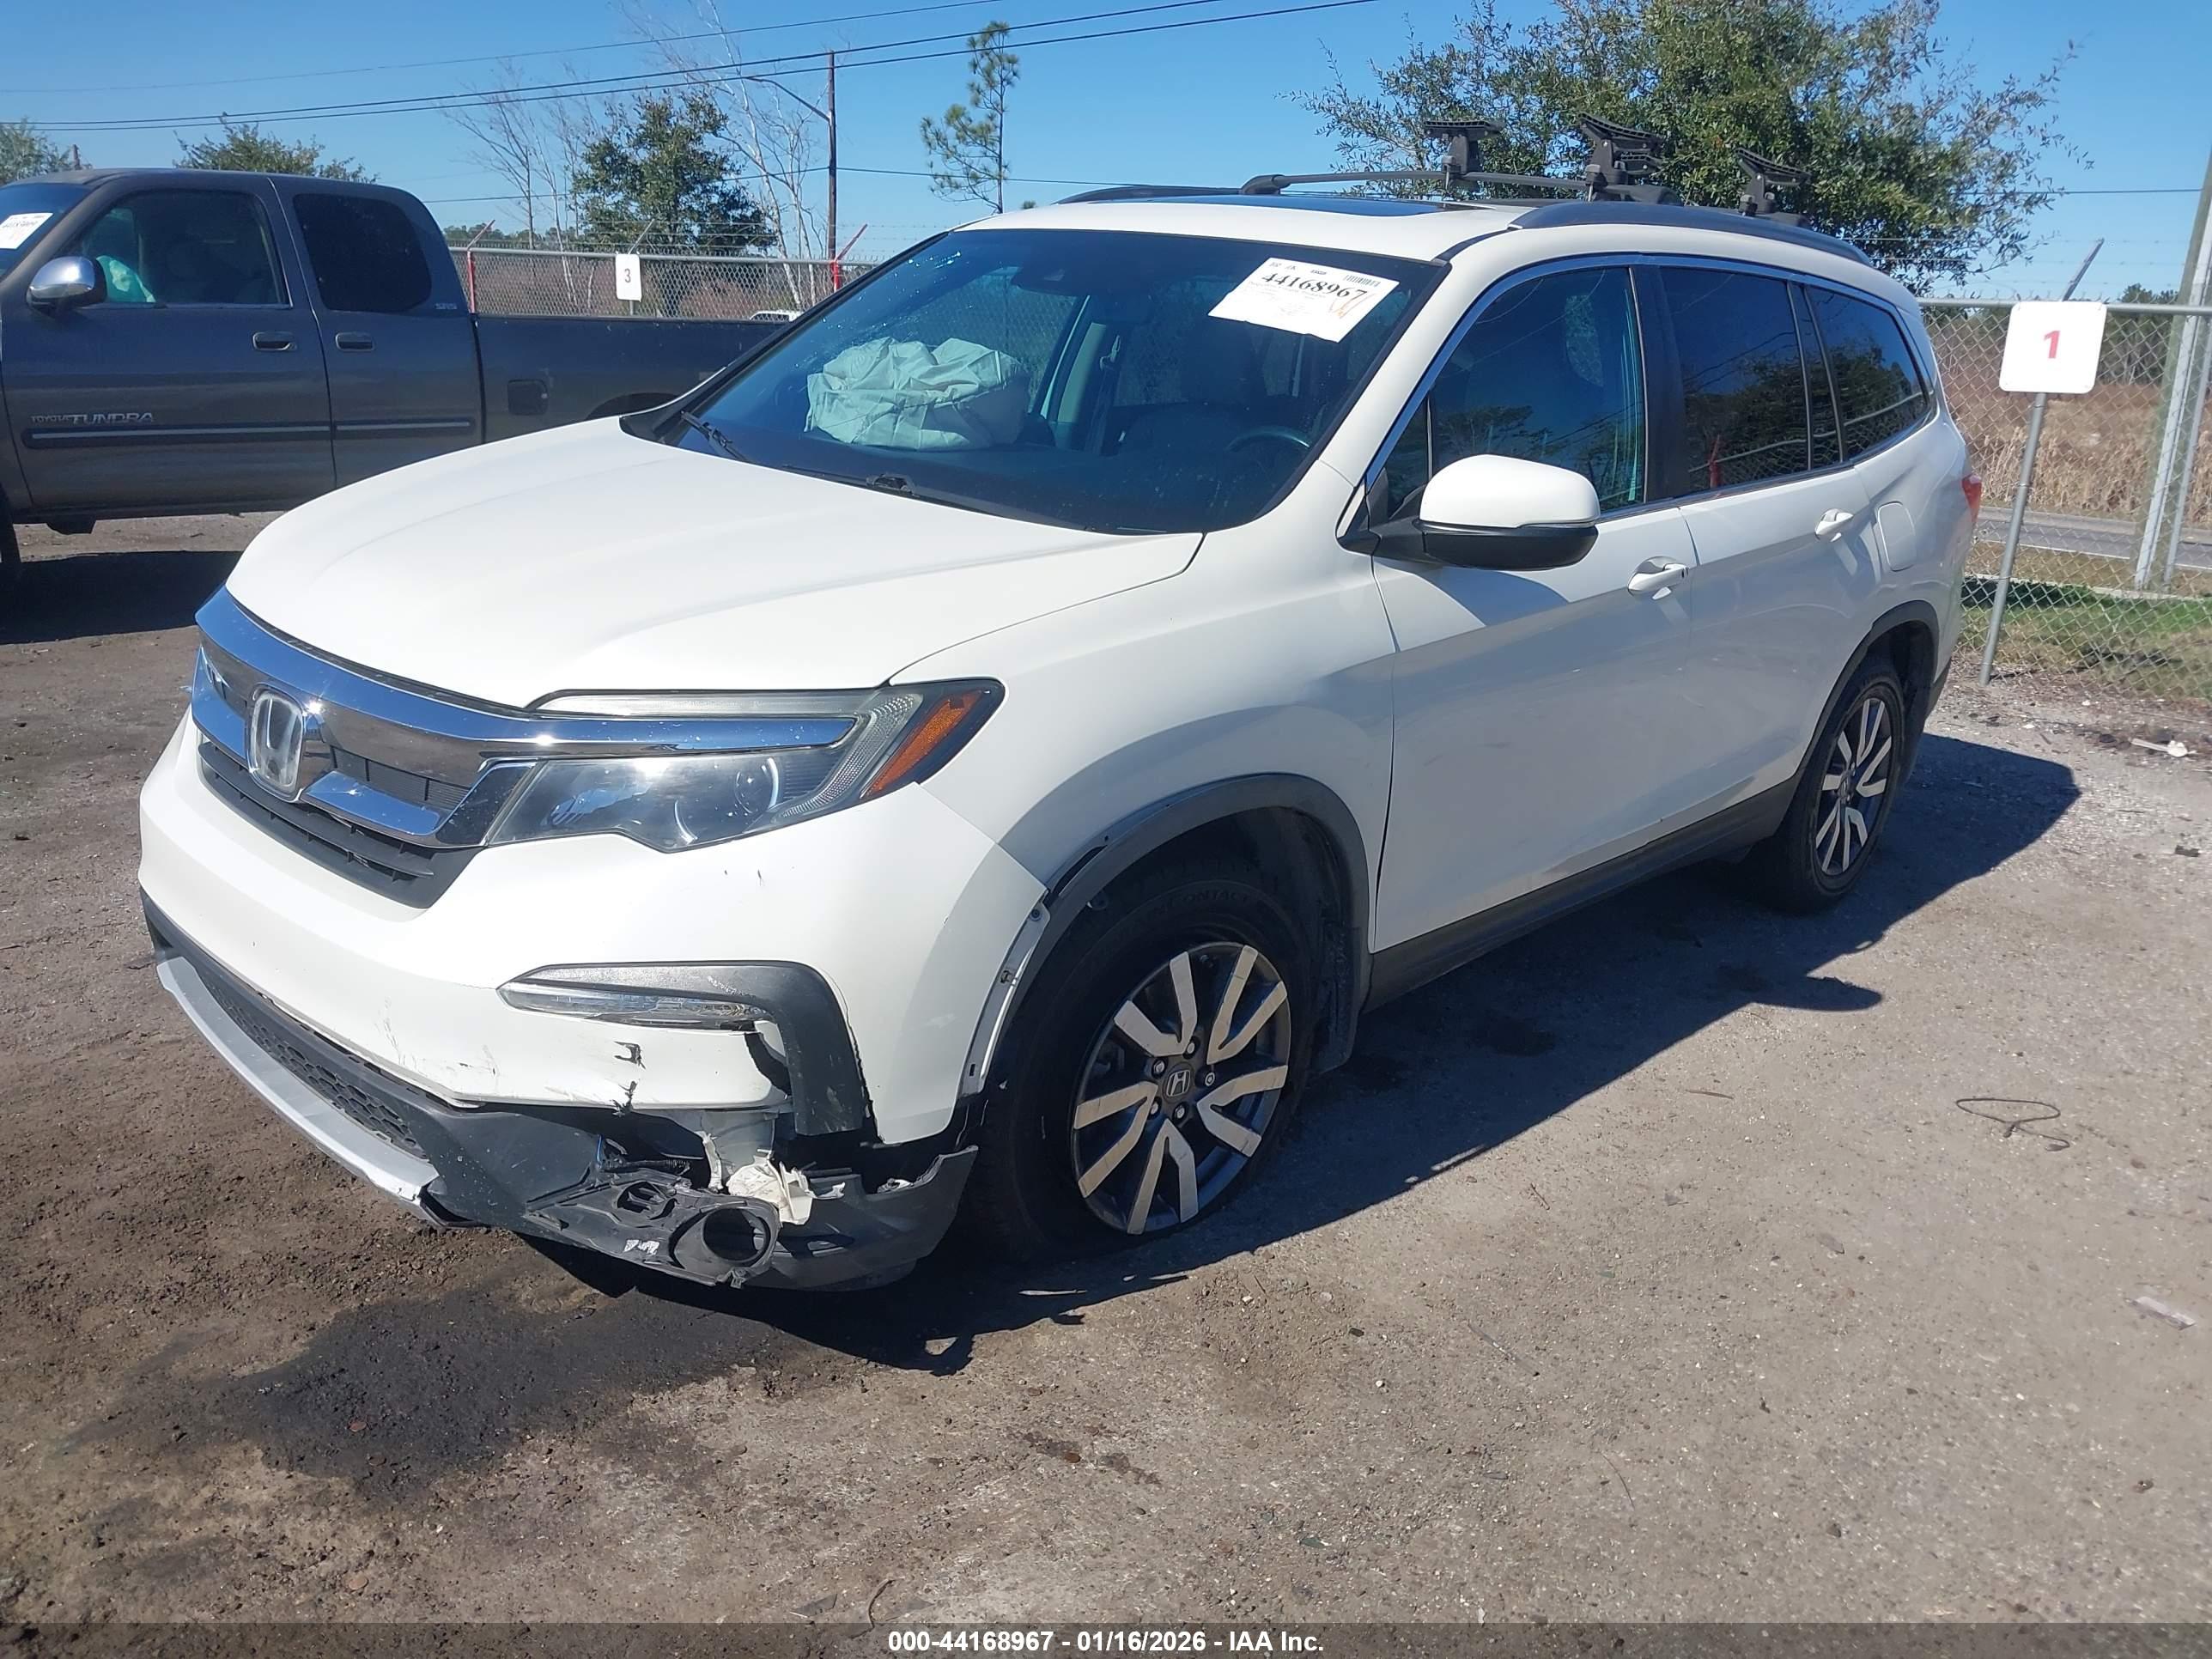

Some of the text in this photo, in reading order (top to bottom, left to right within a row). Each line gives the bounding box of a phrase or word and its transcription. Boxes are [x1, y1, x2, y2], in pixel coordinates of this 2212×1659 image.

[624, 268, 632, 283] 3
[1261, 273, 1368, 301] 44168967
[2044, 330, 2061, 359] 1
[64, 412, 154, 425] TUNDRA
